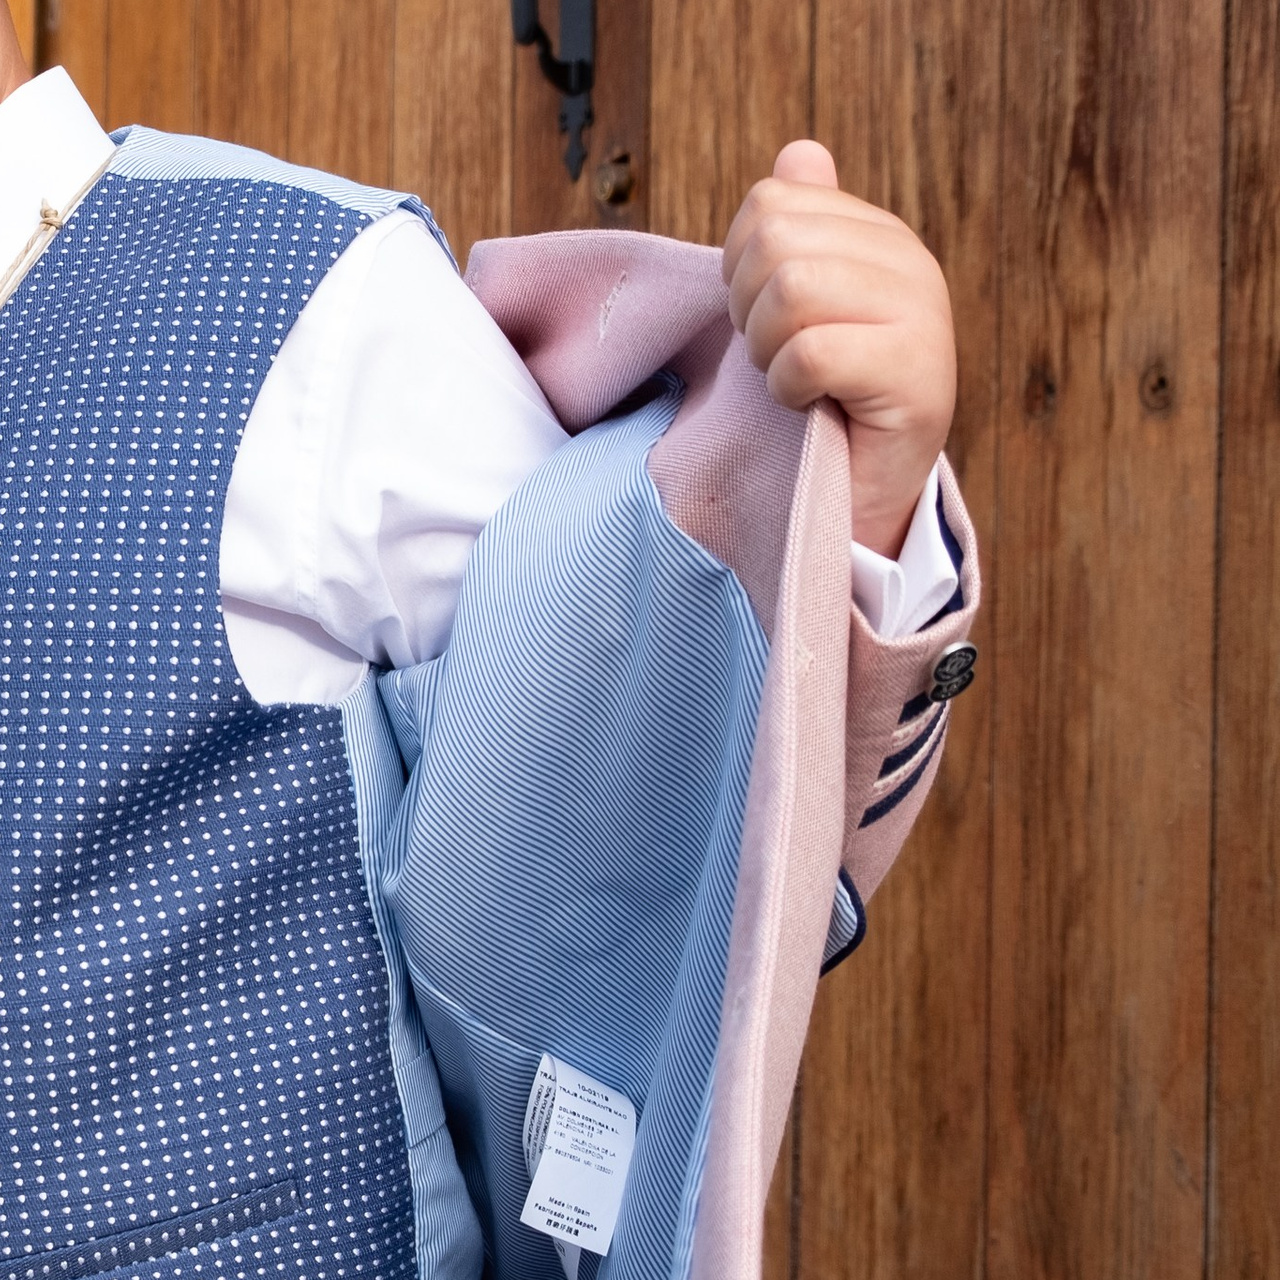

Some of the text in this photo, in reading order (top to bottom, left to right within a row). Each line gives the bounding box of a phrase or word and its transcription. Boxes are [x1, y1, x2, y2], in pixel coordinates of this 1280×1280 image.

[534, 1203, 565, 1219] Fabricado
[548, 1196, 565, 1208] Made
[574, 1206, 591, 1217] Spain
